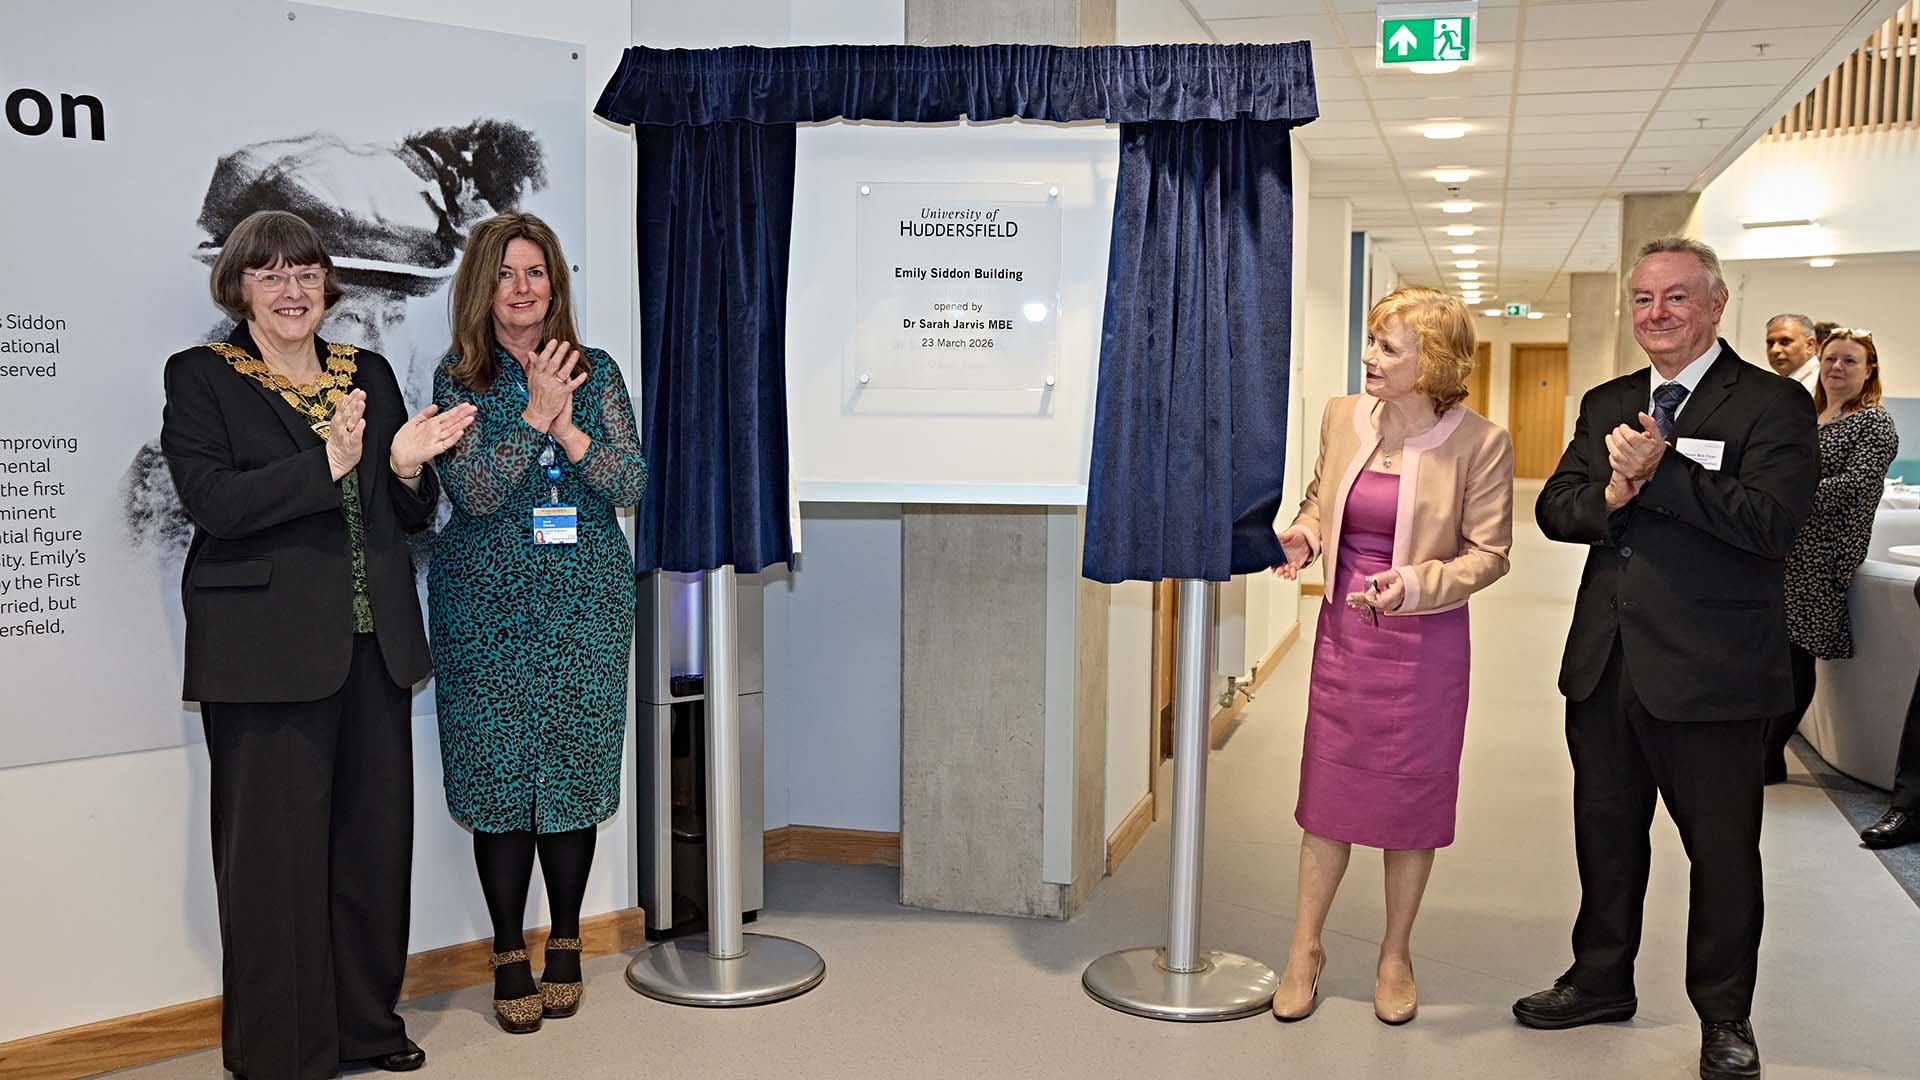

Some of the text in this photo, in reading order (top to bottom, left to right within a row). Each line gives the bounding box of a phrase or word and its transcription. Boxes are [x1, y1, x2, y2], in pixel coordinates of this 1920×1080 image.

[5, 88, 106, 142] on
[921, 208, 1000, 222] University of
[895, 267, 1024, 282] Emily Siddon Building
[933, 302, 983, 313] opened by
[7, 314, 66, 330] Siddon
[903, 318, 1014, 330] Dr Sarah Jarvis MBE
[0, 338, 60, 354] ational
[921, 338, 994, 349] 23 March 2026
[0, 362, 56, 377] served
[0, 480, 66, 498] the first
[0, 527, 83, 546] tial figure
[0, 549, 86, 571] ity. Emily’s
[15, 574, 43, 590] the
[47, 573, 81, 588] First
[0, 595, 77, 614] rried, but
[0, 618, 65, 638] ersfield,
